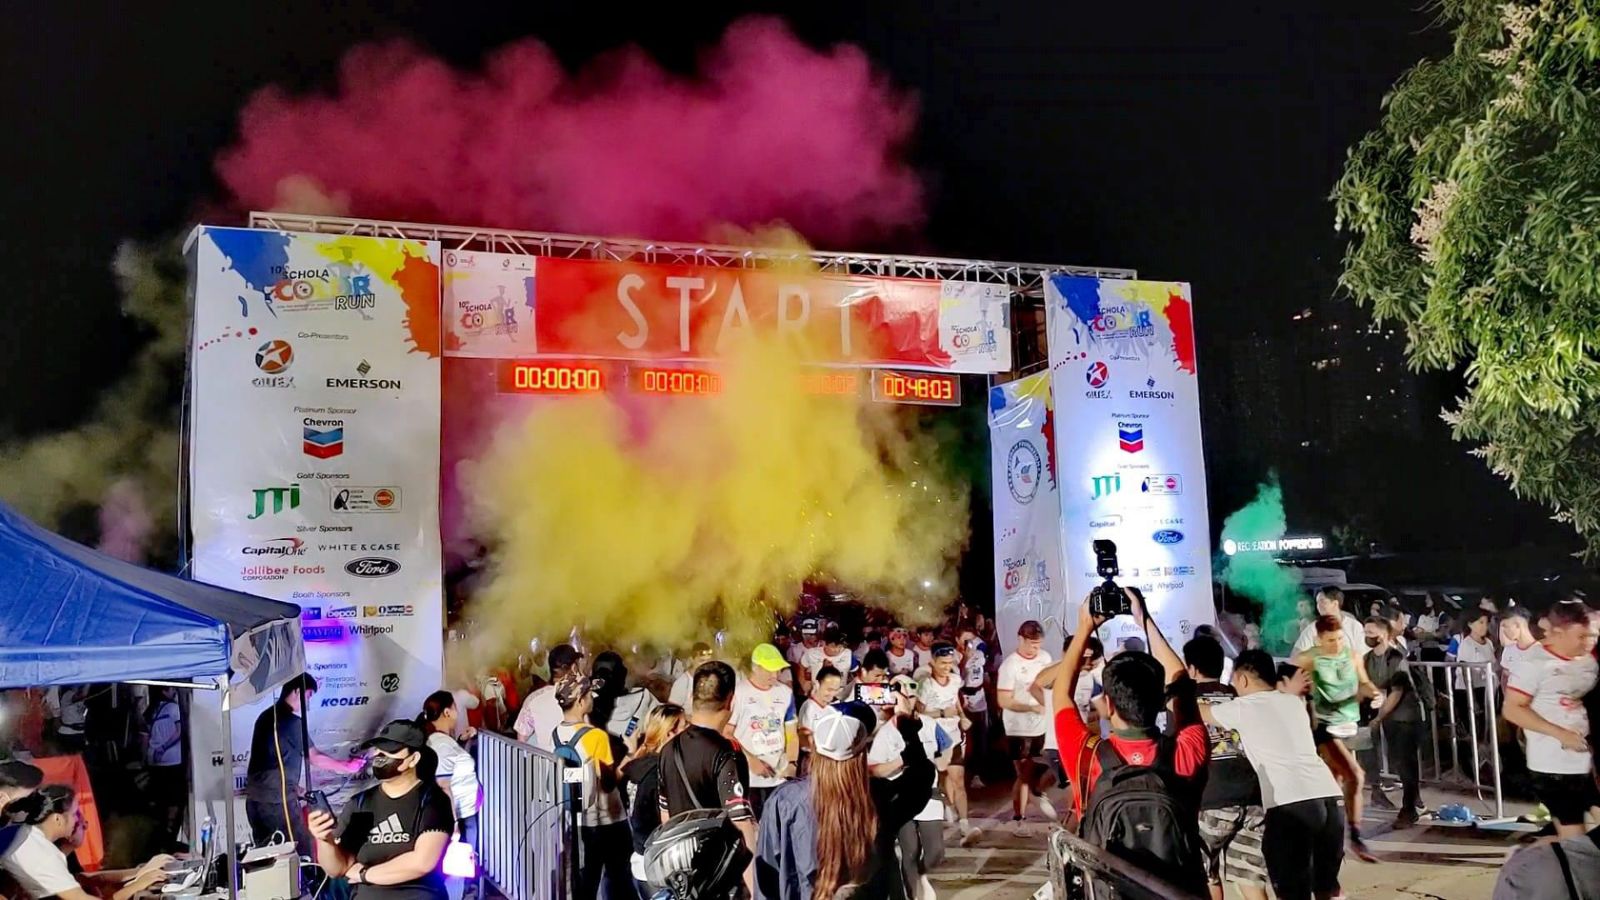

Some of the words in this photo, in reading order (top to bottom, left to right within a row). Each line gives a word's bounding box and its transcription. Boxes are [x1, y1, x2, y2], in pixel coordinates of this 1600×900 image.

[282, 268, 330, 283] SCHOLA
[273, 274, 371, 301] COR
[334, 293, 375, 310] RUN
[465, 303, 492, 313] SCHOLA
[1098, 306, 1126, 317] CHOLA
[460, 307, 517, 329] COR
[616, 272, 864, 356] START
[1092, 310, 1151, 331] COR
[326, 378, 400, 389] EMERSON
[515, 366, 600, 390] 00:00:00
[884, 377, 951, 399] 00:48:03
[1129, 390, 1174, 399] EMERSON
[303, 417, 344, 427] Chevron
[1117, 421, 1143, 429] Chevron
[316, 472, 350, 480] Sponsors
[319, 525, 353, 533] Sponsors
[1158, 532, 1179, 543] Ford
[360, 543, 367, 551] &
[370, 543, 401, 551] CASE
[1237, 540, 1277, 551] RECEATION
[241, 565, 289, 575] Jollibee
[293, 565, 326, 575] Foods
[355, 560, 391, 574] Ford
[316, 591, 350, 599] Sponsors
[349, 624, 394, 637] Whirlpool
[313, 663, 348, 671] Sponsors
[381, 675, 400, 692] C2
[321, 696, 370, 707] KOOLER
